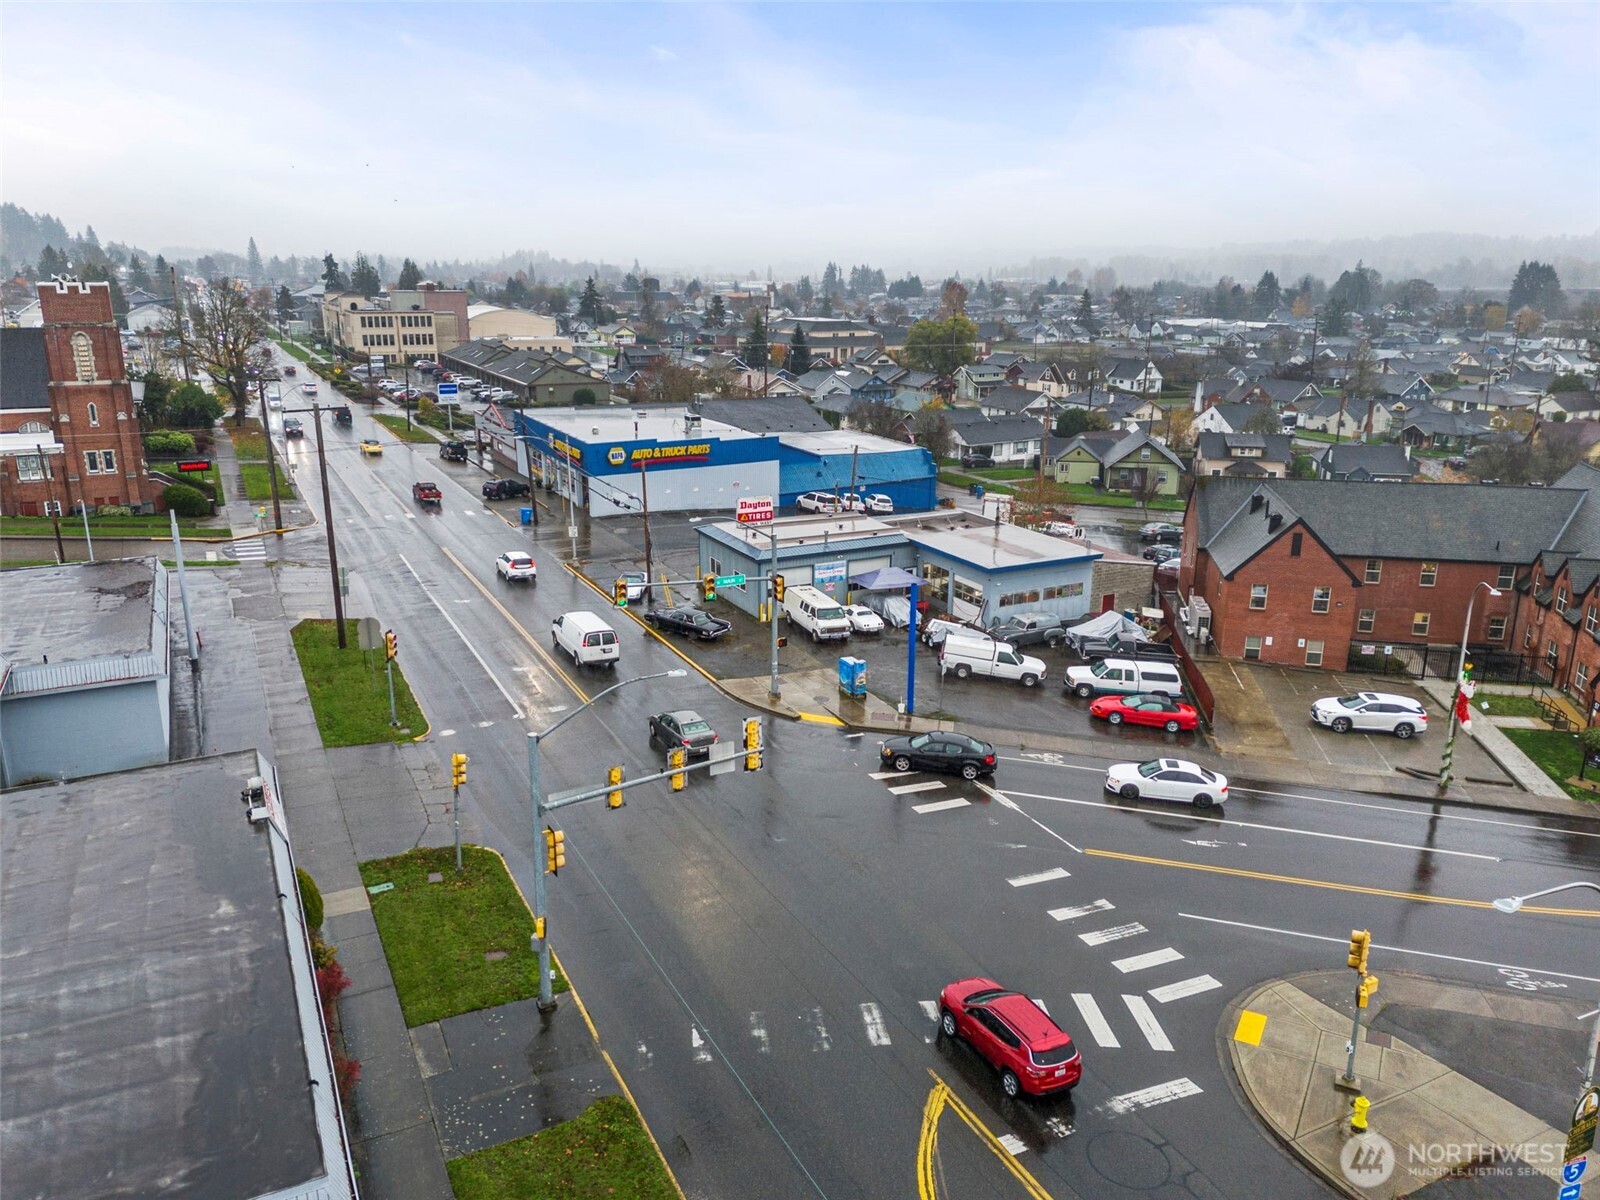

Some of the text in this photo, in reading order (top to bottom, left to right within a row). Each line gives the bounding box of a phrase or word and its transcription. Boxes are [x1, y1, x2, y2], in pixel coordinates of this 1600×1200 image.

[631, 443, 711, 459] AUTO & TRUCK PARTS
[611, 452, 624, 460] NAPA
[740, 501, 772, 509] Dayton
[748, 512, 771, 520] TIRES
[1569, 1163, 1579, 1179] 5
